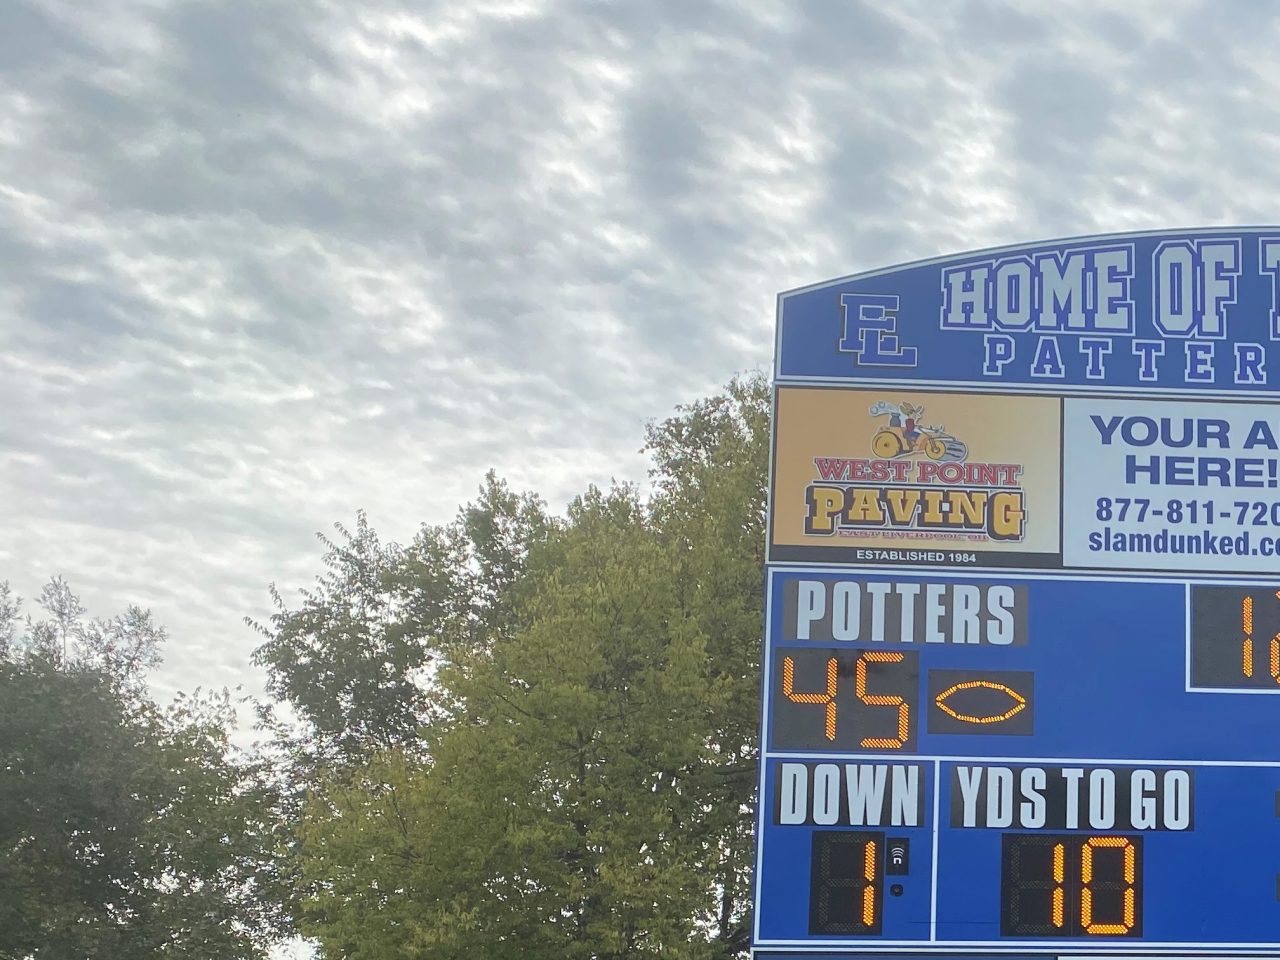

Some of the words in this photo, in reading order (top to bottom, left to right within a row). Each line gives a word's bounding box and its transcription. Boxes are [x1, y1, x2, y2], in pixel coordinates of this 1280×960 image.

[940, 243, 1136, 336] HOME
[1152, 238, 1242, 340] OF
[1090, 416, 1237, 450] YOUR
[814, 458, 912, 482] WEST
[917, 461, 1023, 486] POINT
[1125, 455, 1278, 488] HERE!
[804, 485, 1027, 542] PAVING
[856, 549, 945, 562] ESTABLISHED
[949, 552, 977, 563] 1984
[797, 580, 1016, 646] POTTERS
[782, 651, 910, 749] 45
[779, 762, 919, 827] DOWN
[956, 765, 1048, 829] YDS
[1061, 768, 1116, 829] TO
[1130, 768, 1191, 831] GO
[861, 840, 878, 927] 1
[1051, 835, 1135, 935] 10
